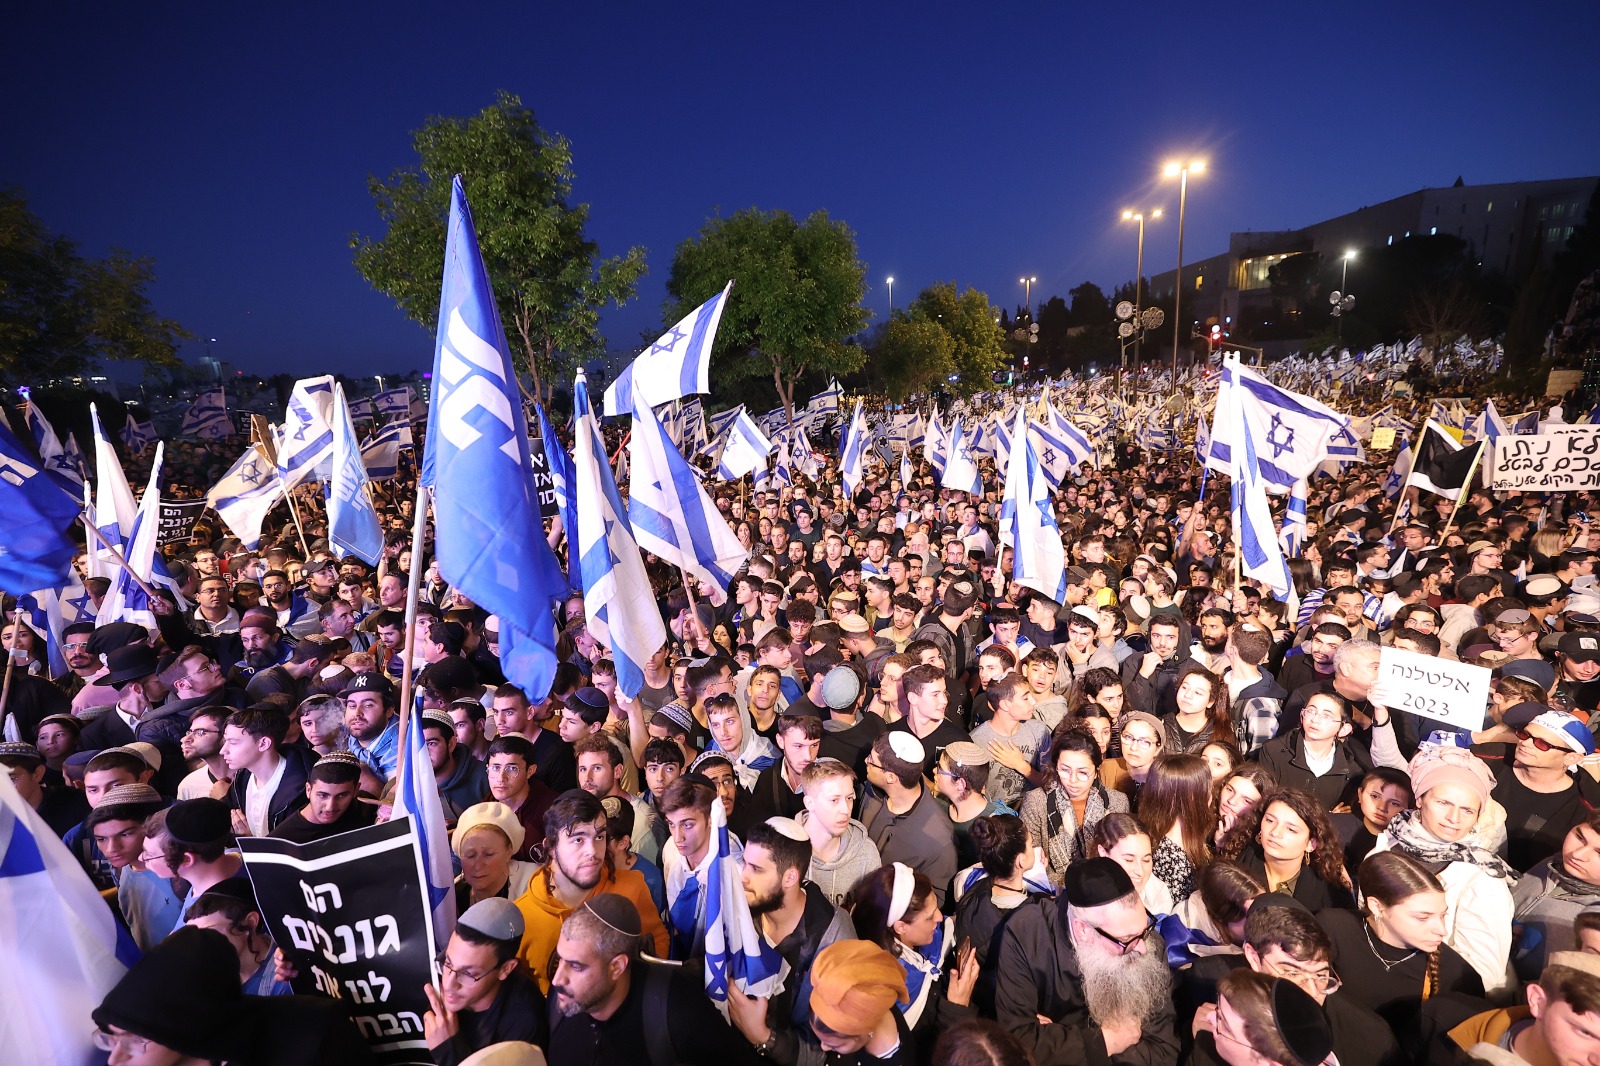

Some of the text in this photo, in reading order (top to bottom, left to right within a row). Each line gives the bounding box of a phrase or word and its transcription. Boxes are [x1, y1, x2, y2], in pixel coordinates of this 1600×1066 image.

[1502, 434, 1600, 460] לא ניתן
[1498, 456, 1548, 472] לבטל
[533, 470, 552, 488] אז
[1540, 474, 1574, 488] הקול
[538, 489, 556, 506] סו
[159, 516, 195, 528] גונבי
[163, 508, 182, 516] הם
[354, 675, 368, 688] NY
[1391, 663, 1470, 694] אלטלנה
[1402, 692, 1450, 717] 2023
[299, 879, 343, 914] הם
[282, 914, 401, 965] גונבים
[310, 964, 392, 1004] לנו את
[349, 1011, 424, 1039] הבח
